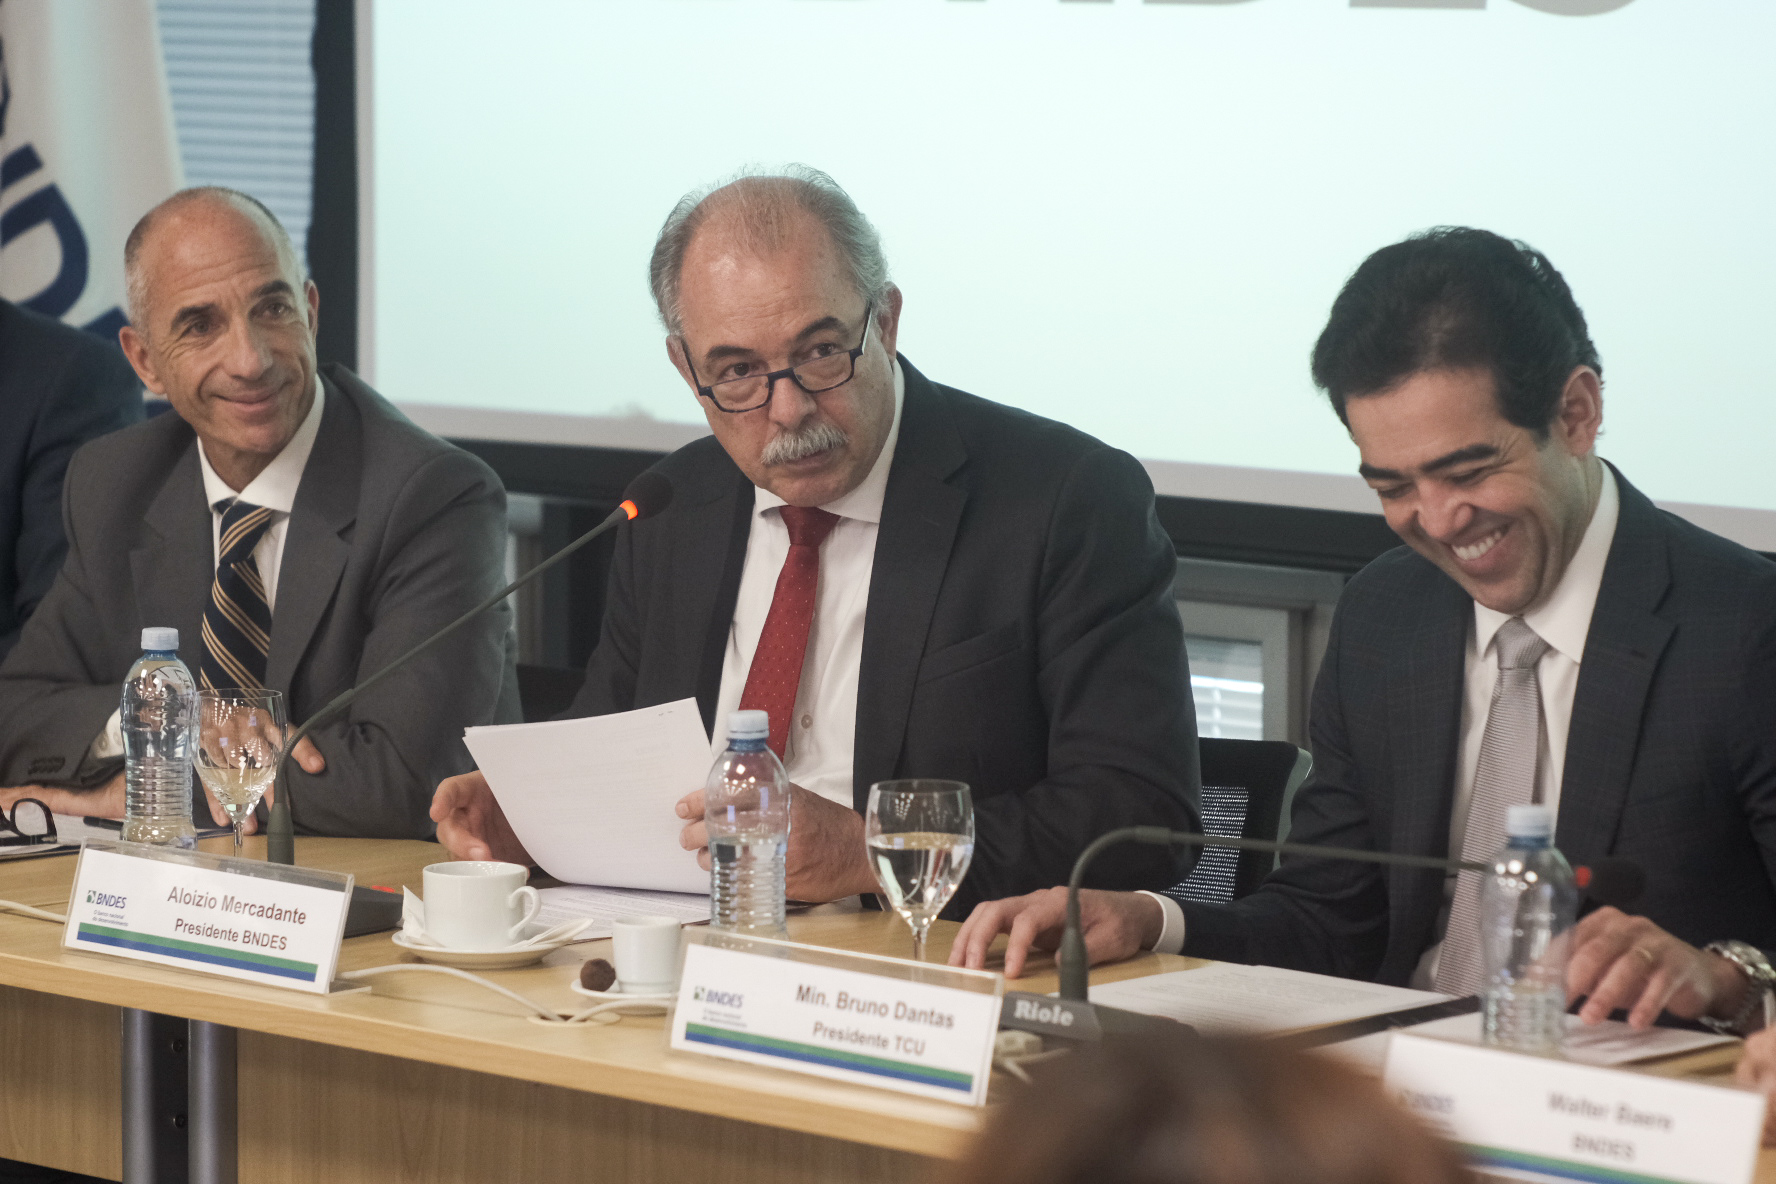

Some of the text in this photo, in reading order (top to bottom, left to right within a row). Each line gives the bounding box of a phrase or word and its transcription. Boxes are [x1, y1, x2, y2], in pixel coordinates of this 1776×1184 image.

[96, 892, 127, 909] BNDES
[167, 886, 307, 925] Aloizio Mercadante
[174, 918, 287, 951] Presidente BNDES
[796, 984, 955, 1030] Min. Bruno Dantas
[1014, 999, 1074, 1026] Riole
[813, 1021, 926, 1056] Presidente TCU
